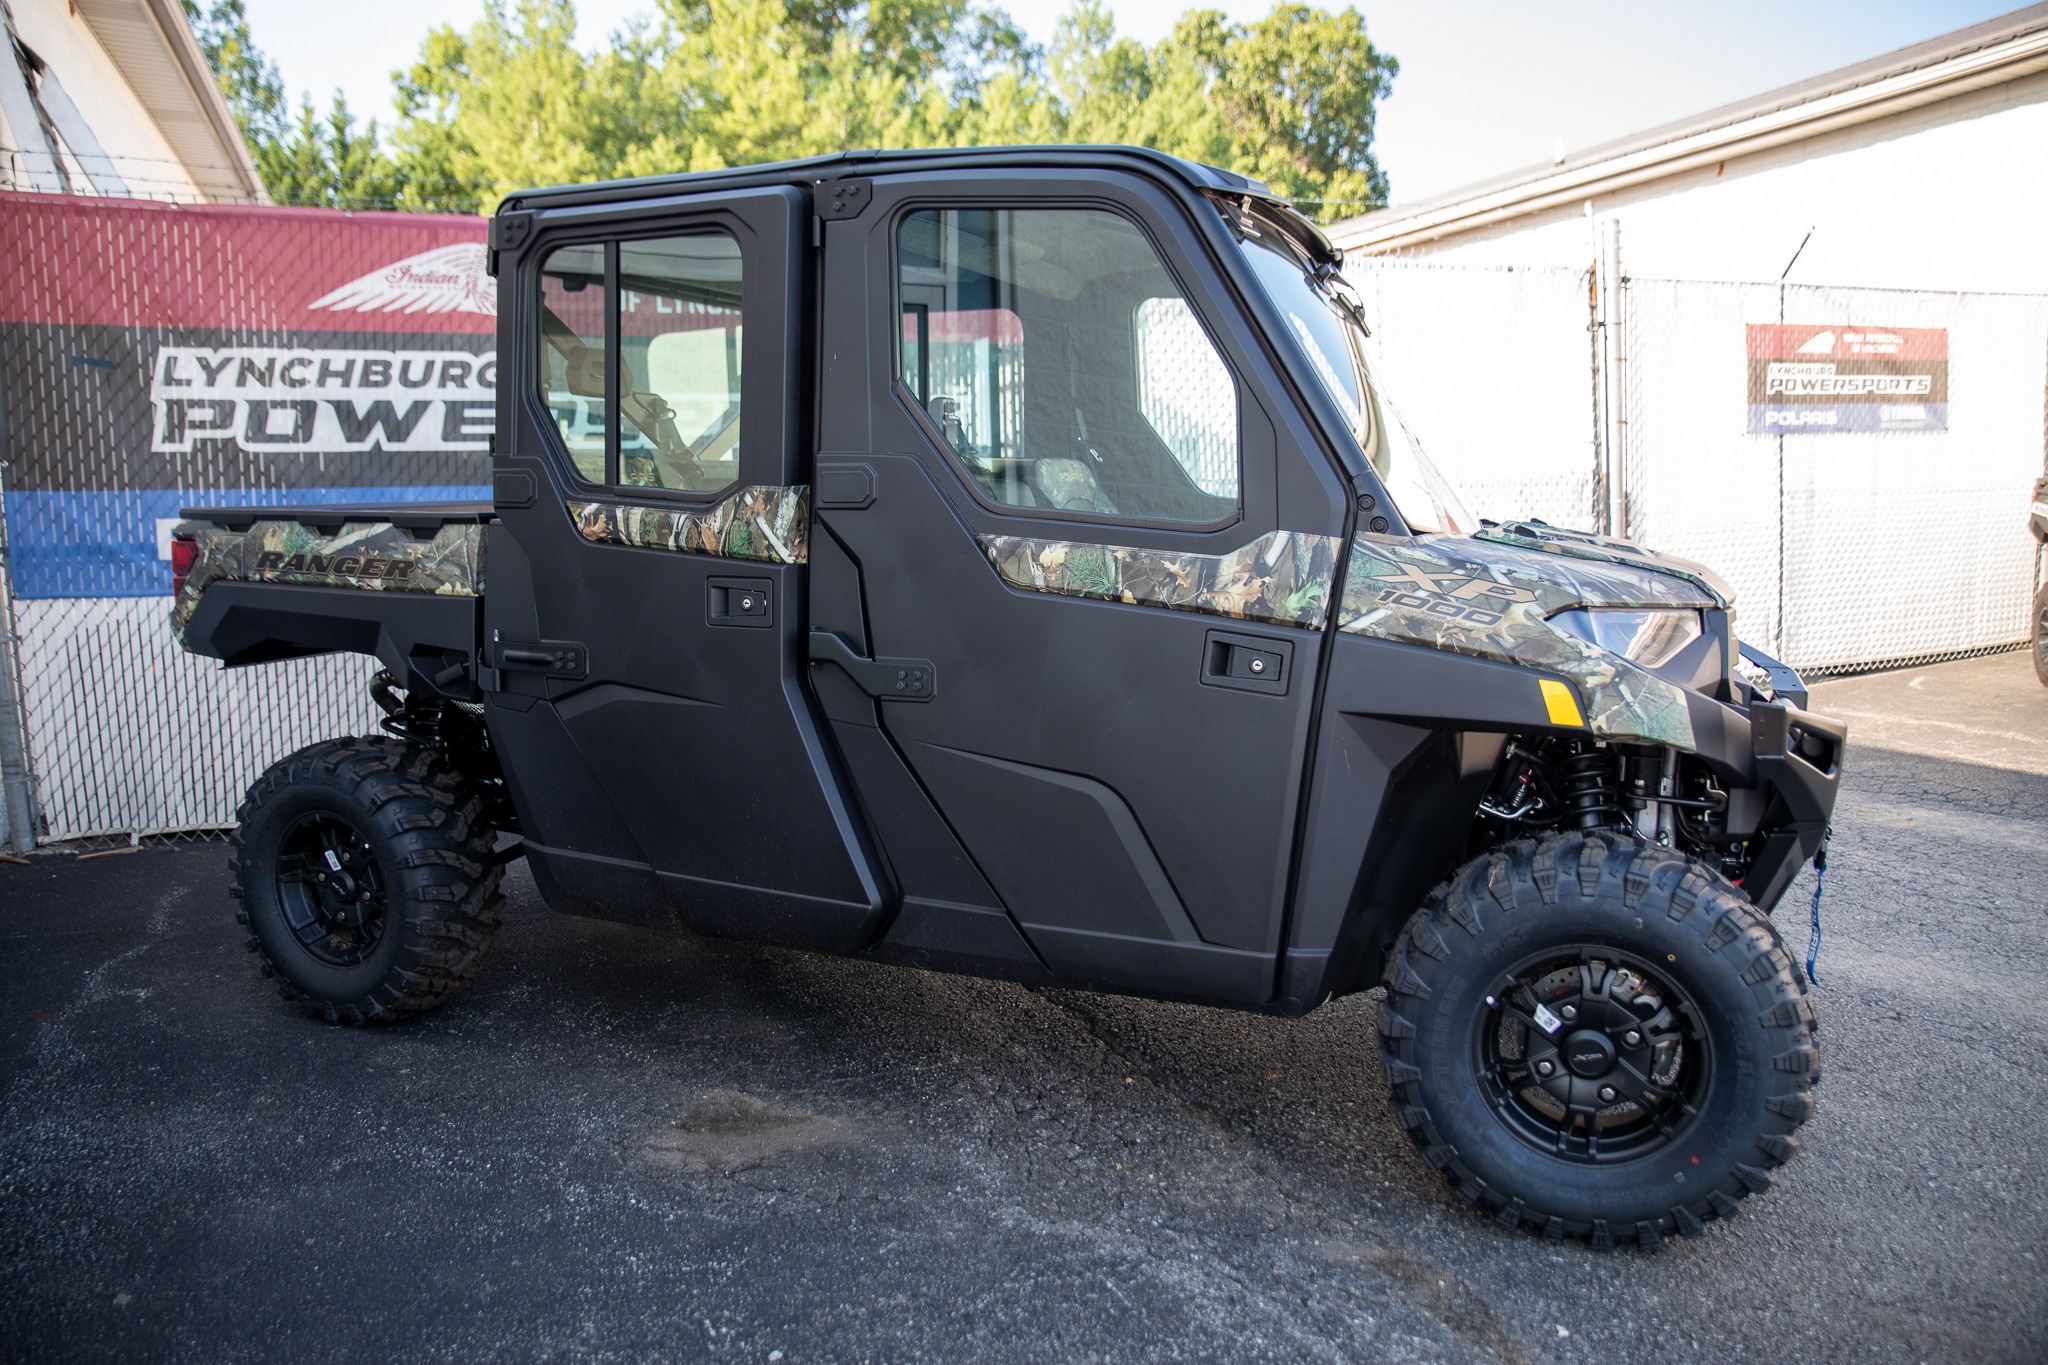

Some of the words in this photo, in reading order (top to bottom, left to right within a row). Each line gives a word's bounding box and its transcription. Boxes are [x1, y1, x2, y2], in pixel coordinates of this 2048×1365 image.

[385, 265, 460, 285] Indian
[162, 356, 497, 389] LYNCHBURG
[1768, 377, 1930, 392] POWERSPORTS
[1769, 365, 1834, 376] LYNCHBURG
[1765, 410, 1838, 426] POLARIS
[255, 551, 416, 581] RANGER
[1367, 560, 1539, 603] XP
[1374, 588, 1505, 627] 1000
[1807, 896, 1820, 962] POLARIS
